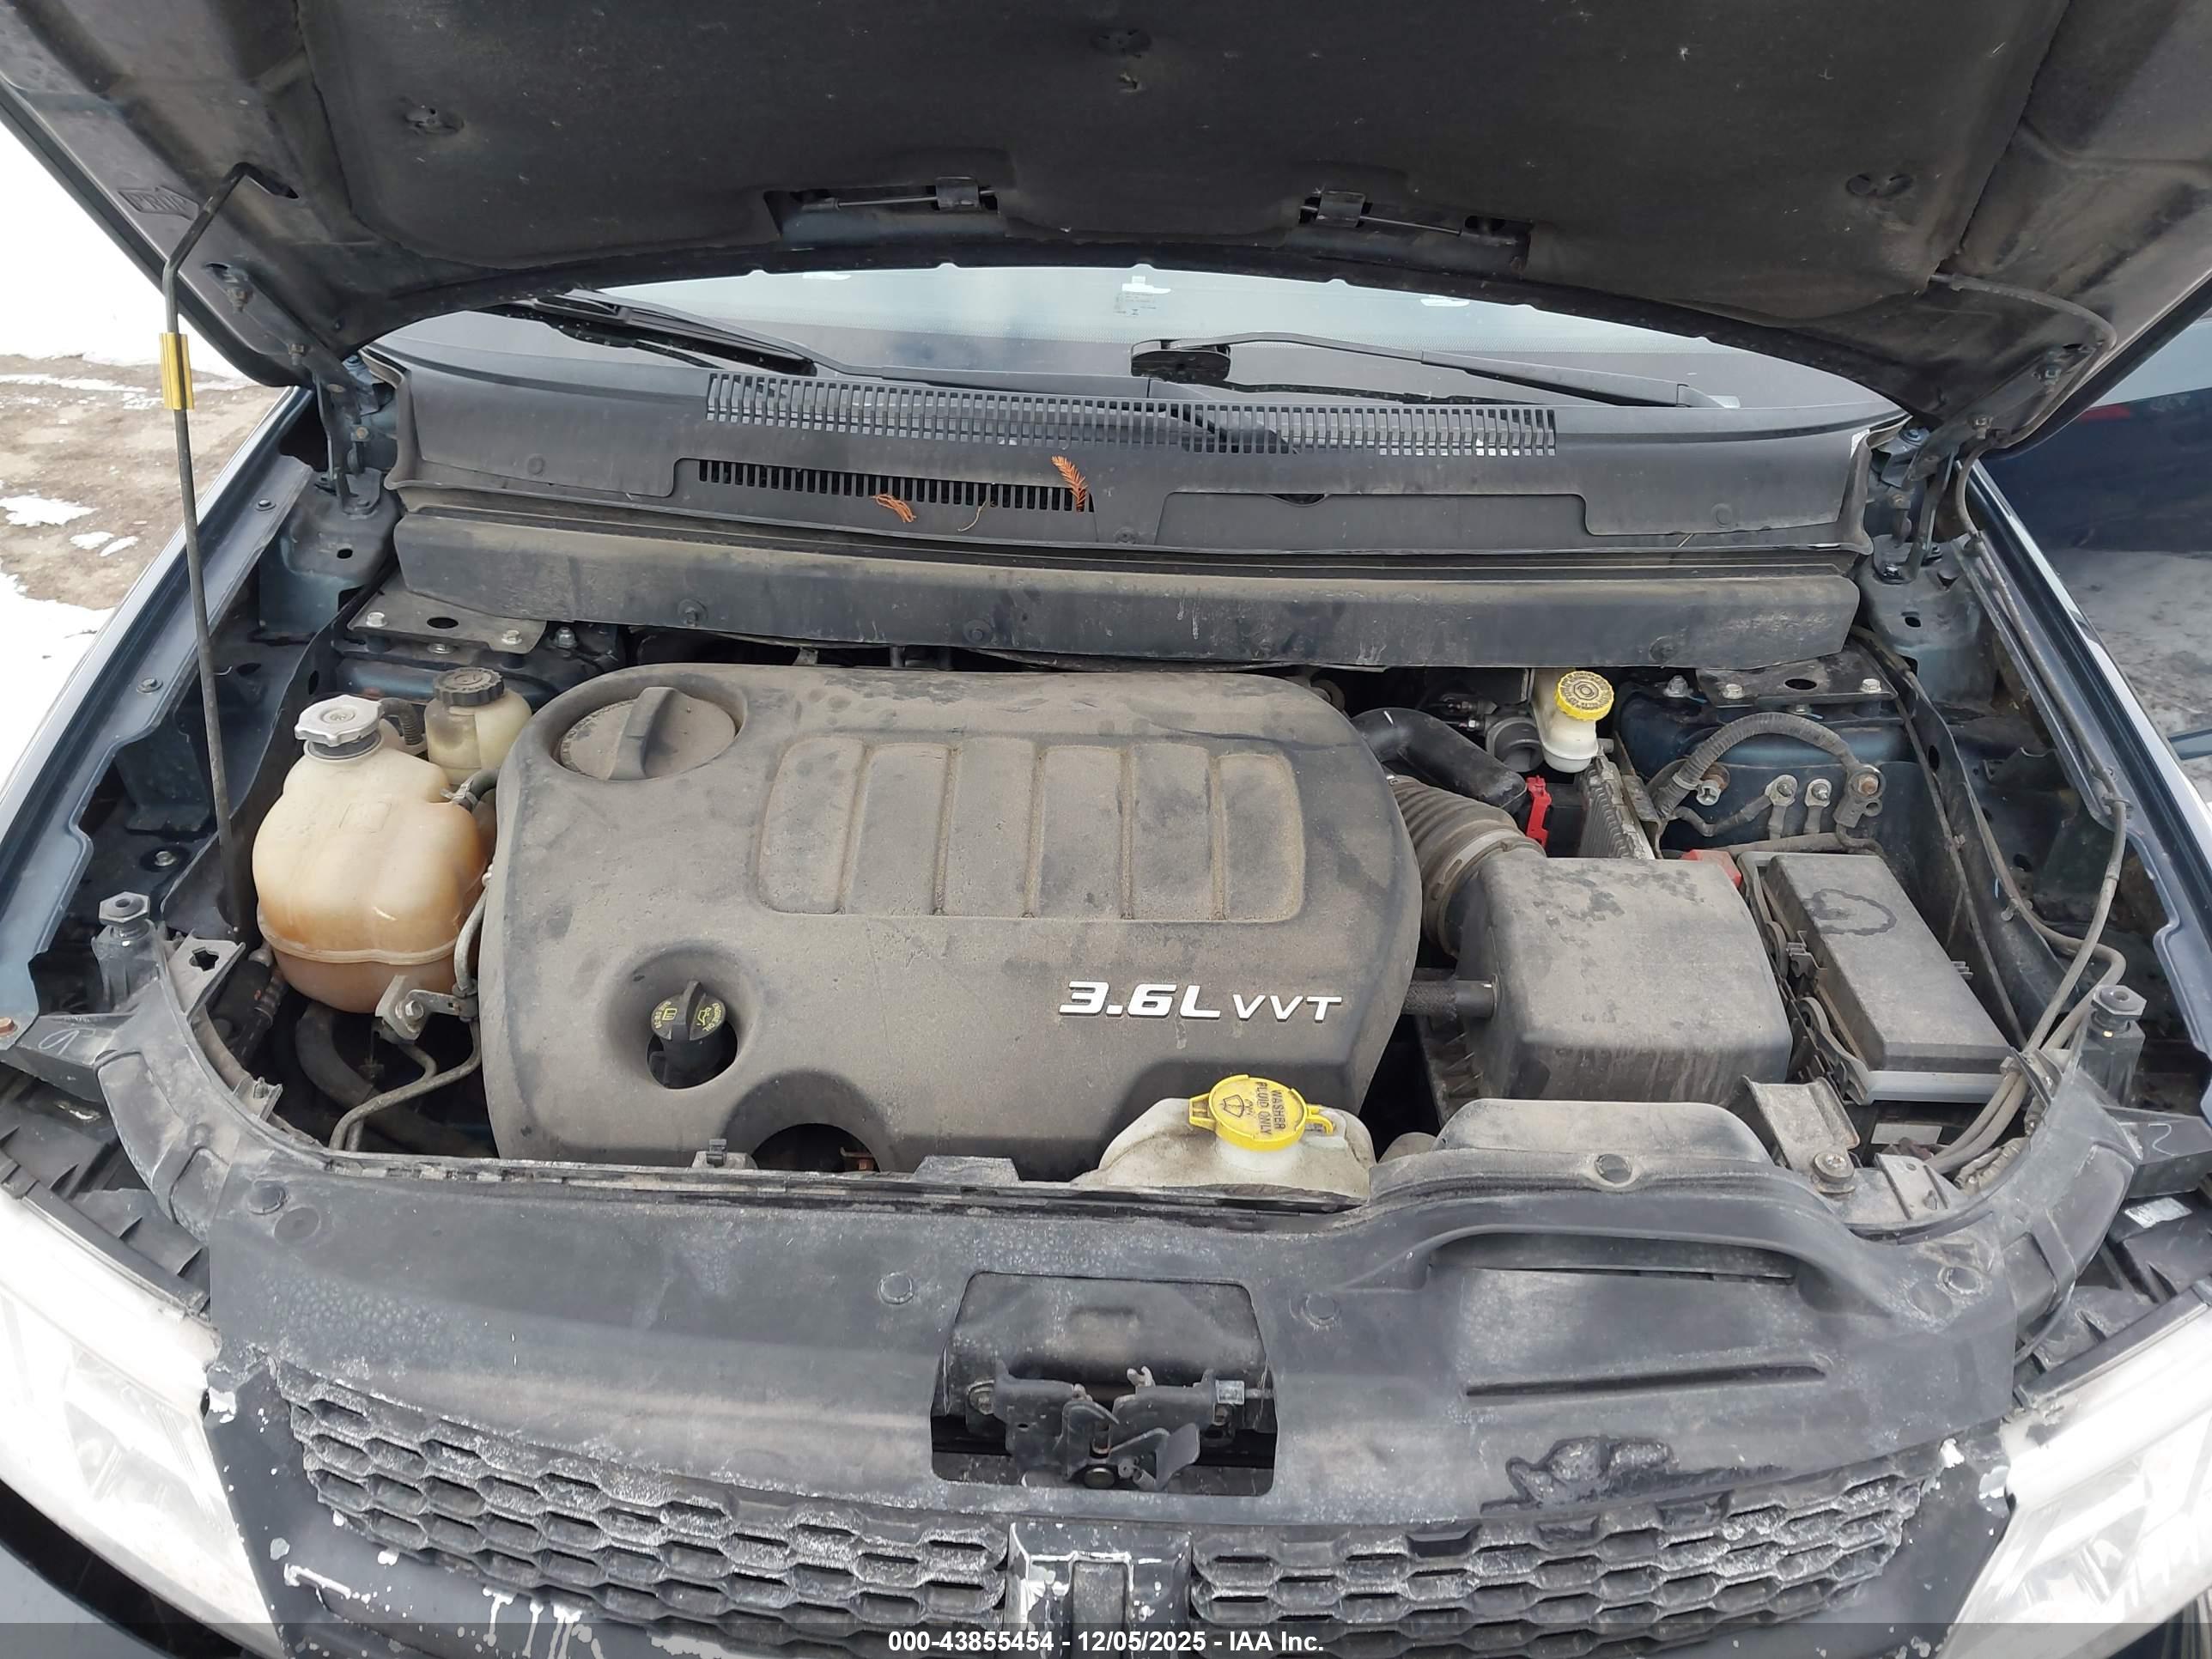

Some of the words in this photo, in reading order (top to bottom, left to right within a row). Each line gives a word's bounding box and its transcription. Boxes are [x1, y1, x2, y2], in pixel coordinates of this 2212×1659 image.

[1059, 981, 1221, 1019] 3.6L
[1232, 994, 1342, 1023] VVT
[1255, 1081, 1269, 1109] FLUID
[1271, 1090, 1286, 1130] WASHER
[1258, 1111, 1272, 1134] ONLY
